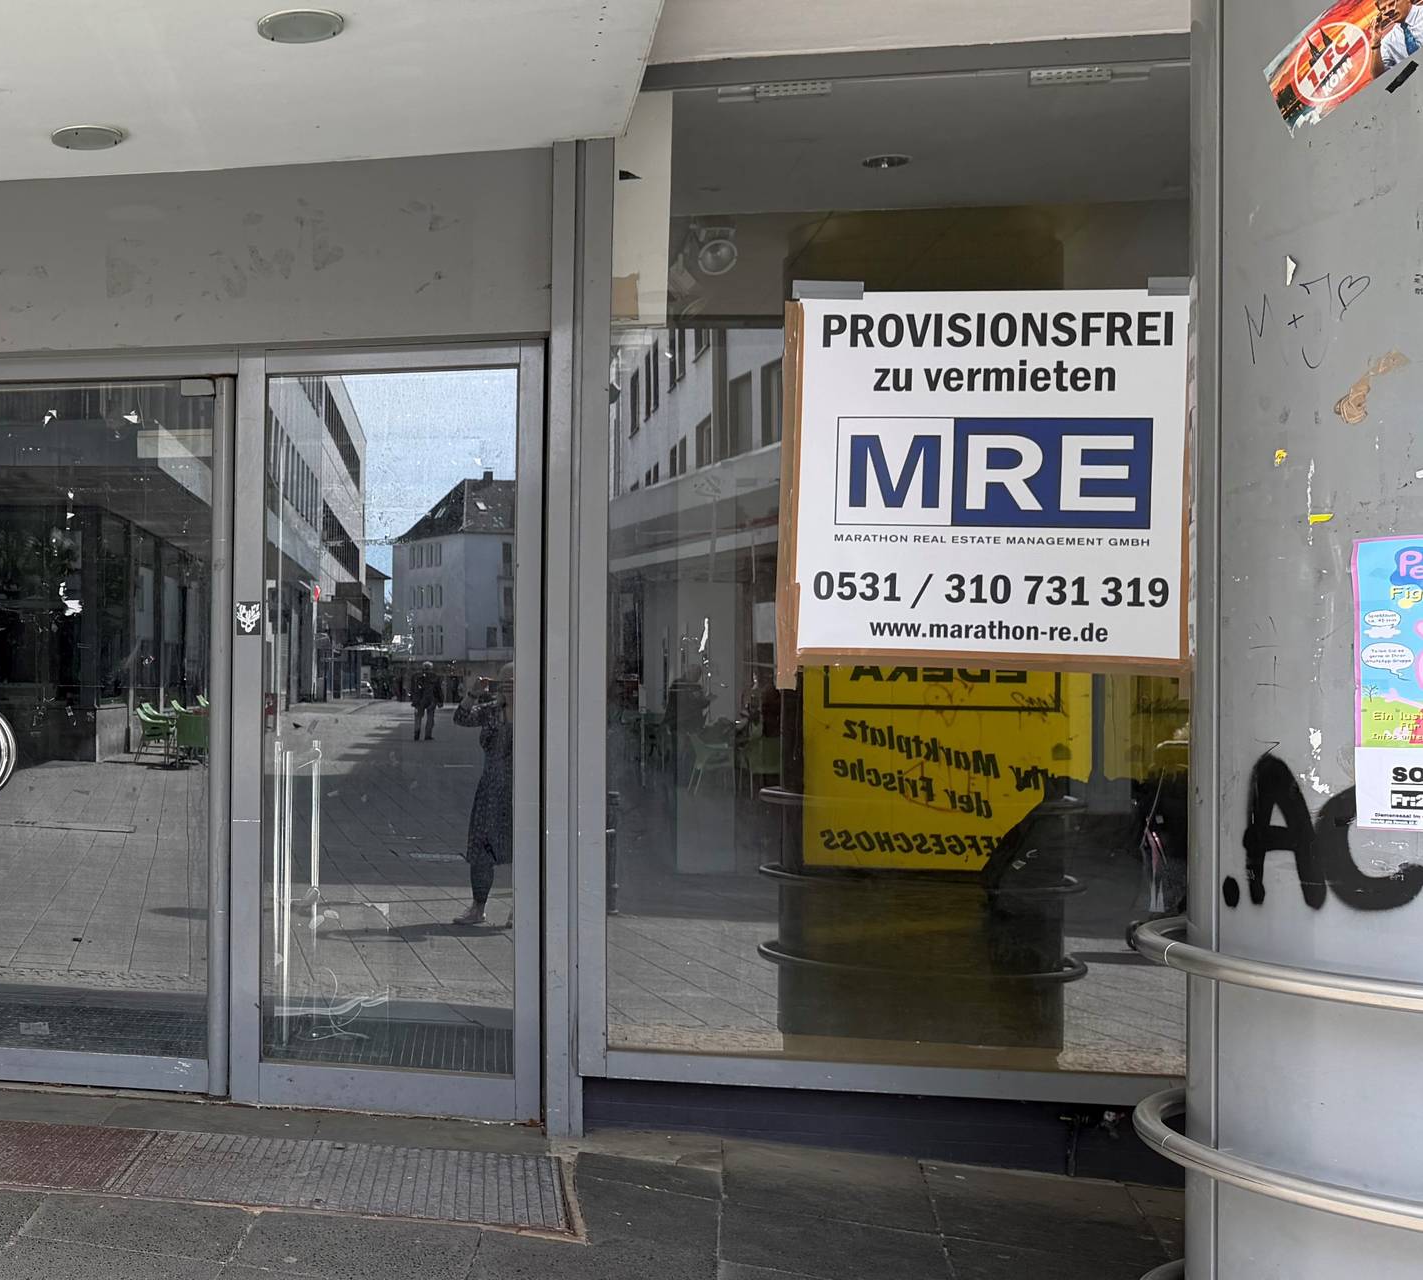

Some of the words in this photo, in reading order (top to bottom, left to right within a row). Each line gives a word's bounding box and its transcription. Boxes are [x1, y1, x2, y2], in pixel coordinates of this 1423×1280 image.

[822, 311, 1174, 348] PROVISIONSFREI
[873, 367, 913, 392] zu
[923, 359, 1116, 392] vermieten
[848, 433, 1138, 513] MRE
[833, 533, 909, 543] MARATHON
[913, 535, 947, 544] REAL
[950, 536, 1002, 545] ESTATE
[1005, 536, 1104, 546] MANAGEMENT
[1107, 537, 1151, 547] GMBH
[813, 571, 901, 602] 0531
[910, 573, 934, 609] /
[944, 574, 1012, 605] 310
[1023, 575, 1090, 606] 731
[1100, 576, 1170, 608] 319
[869, 620, 1109, 643] www.marathon-re.de
[1374, 712, 1394, 721] Ein
